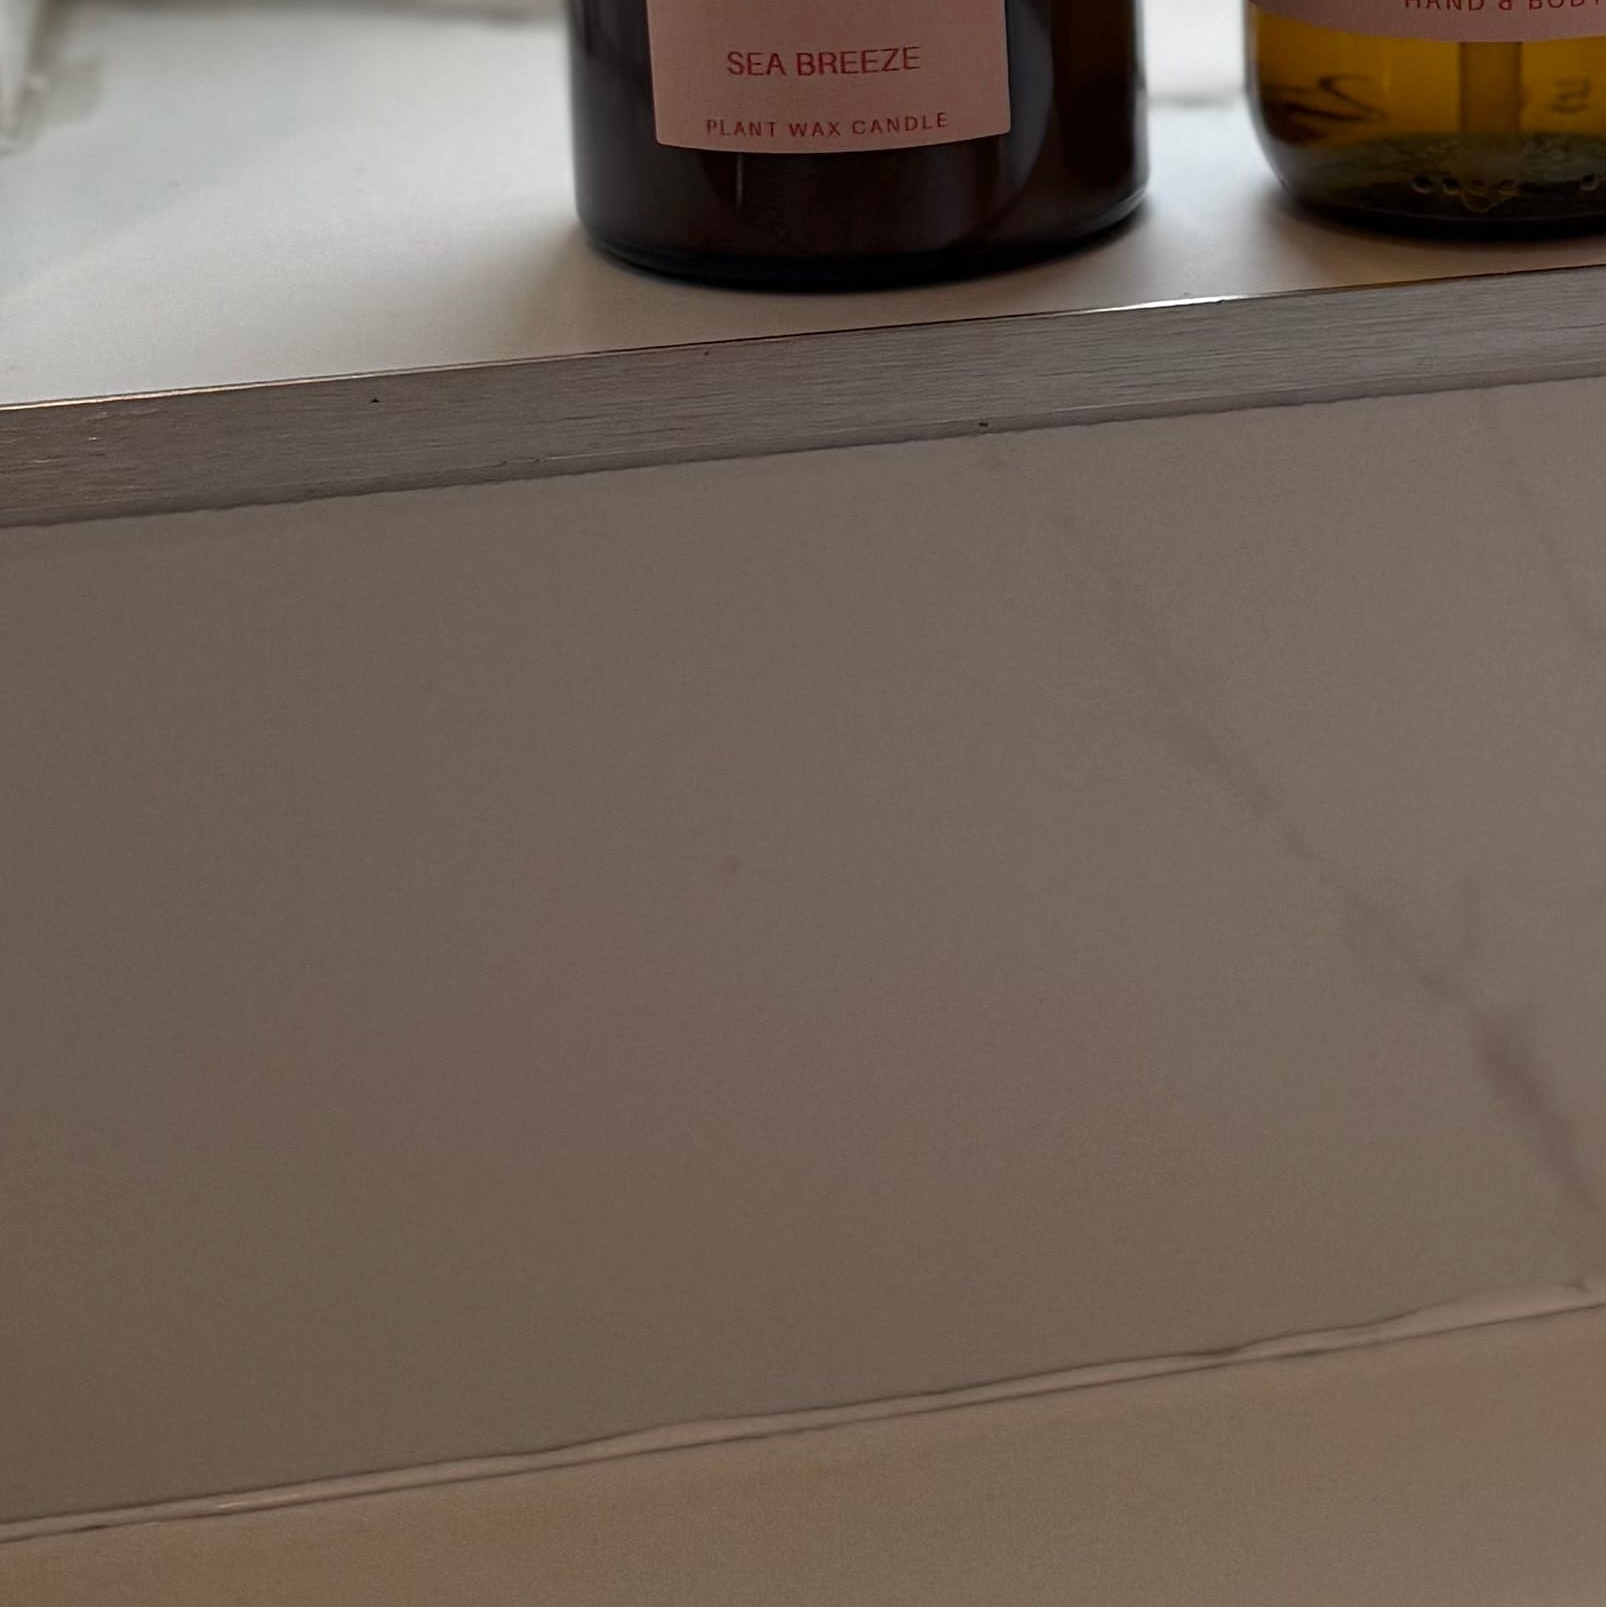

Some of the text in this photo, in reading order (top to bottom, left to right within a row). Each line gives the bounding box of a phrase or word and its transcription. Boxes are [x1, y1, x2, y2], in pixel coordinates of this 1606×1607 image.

[726, 45, 921, 77] SEA BREEZE
[705, 111, 950, 138] PLANT WAX CANDLE
